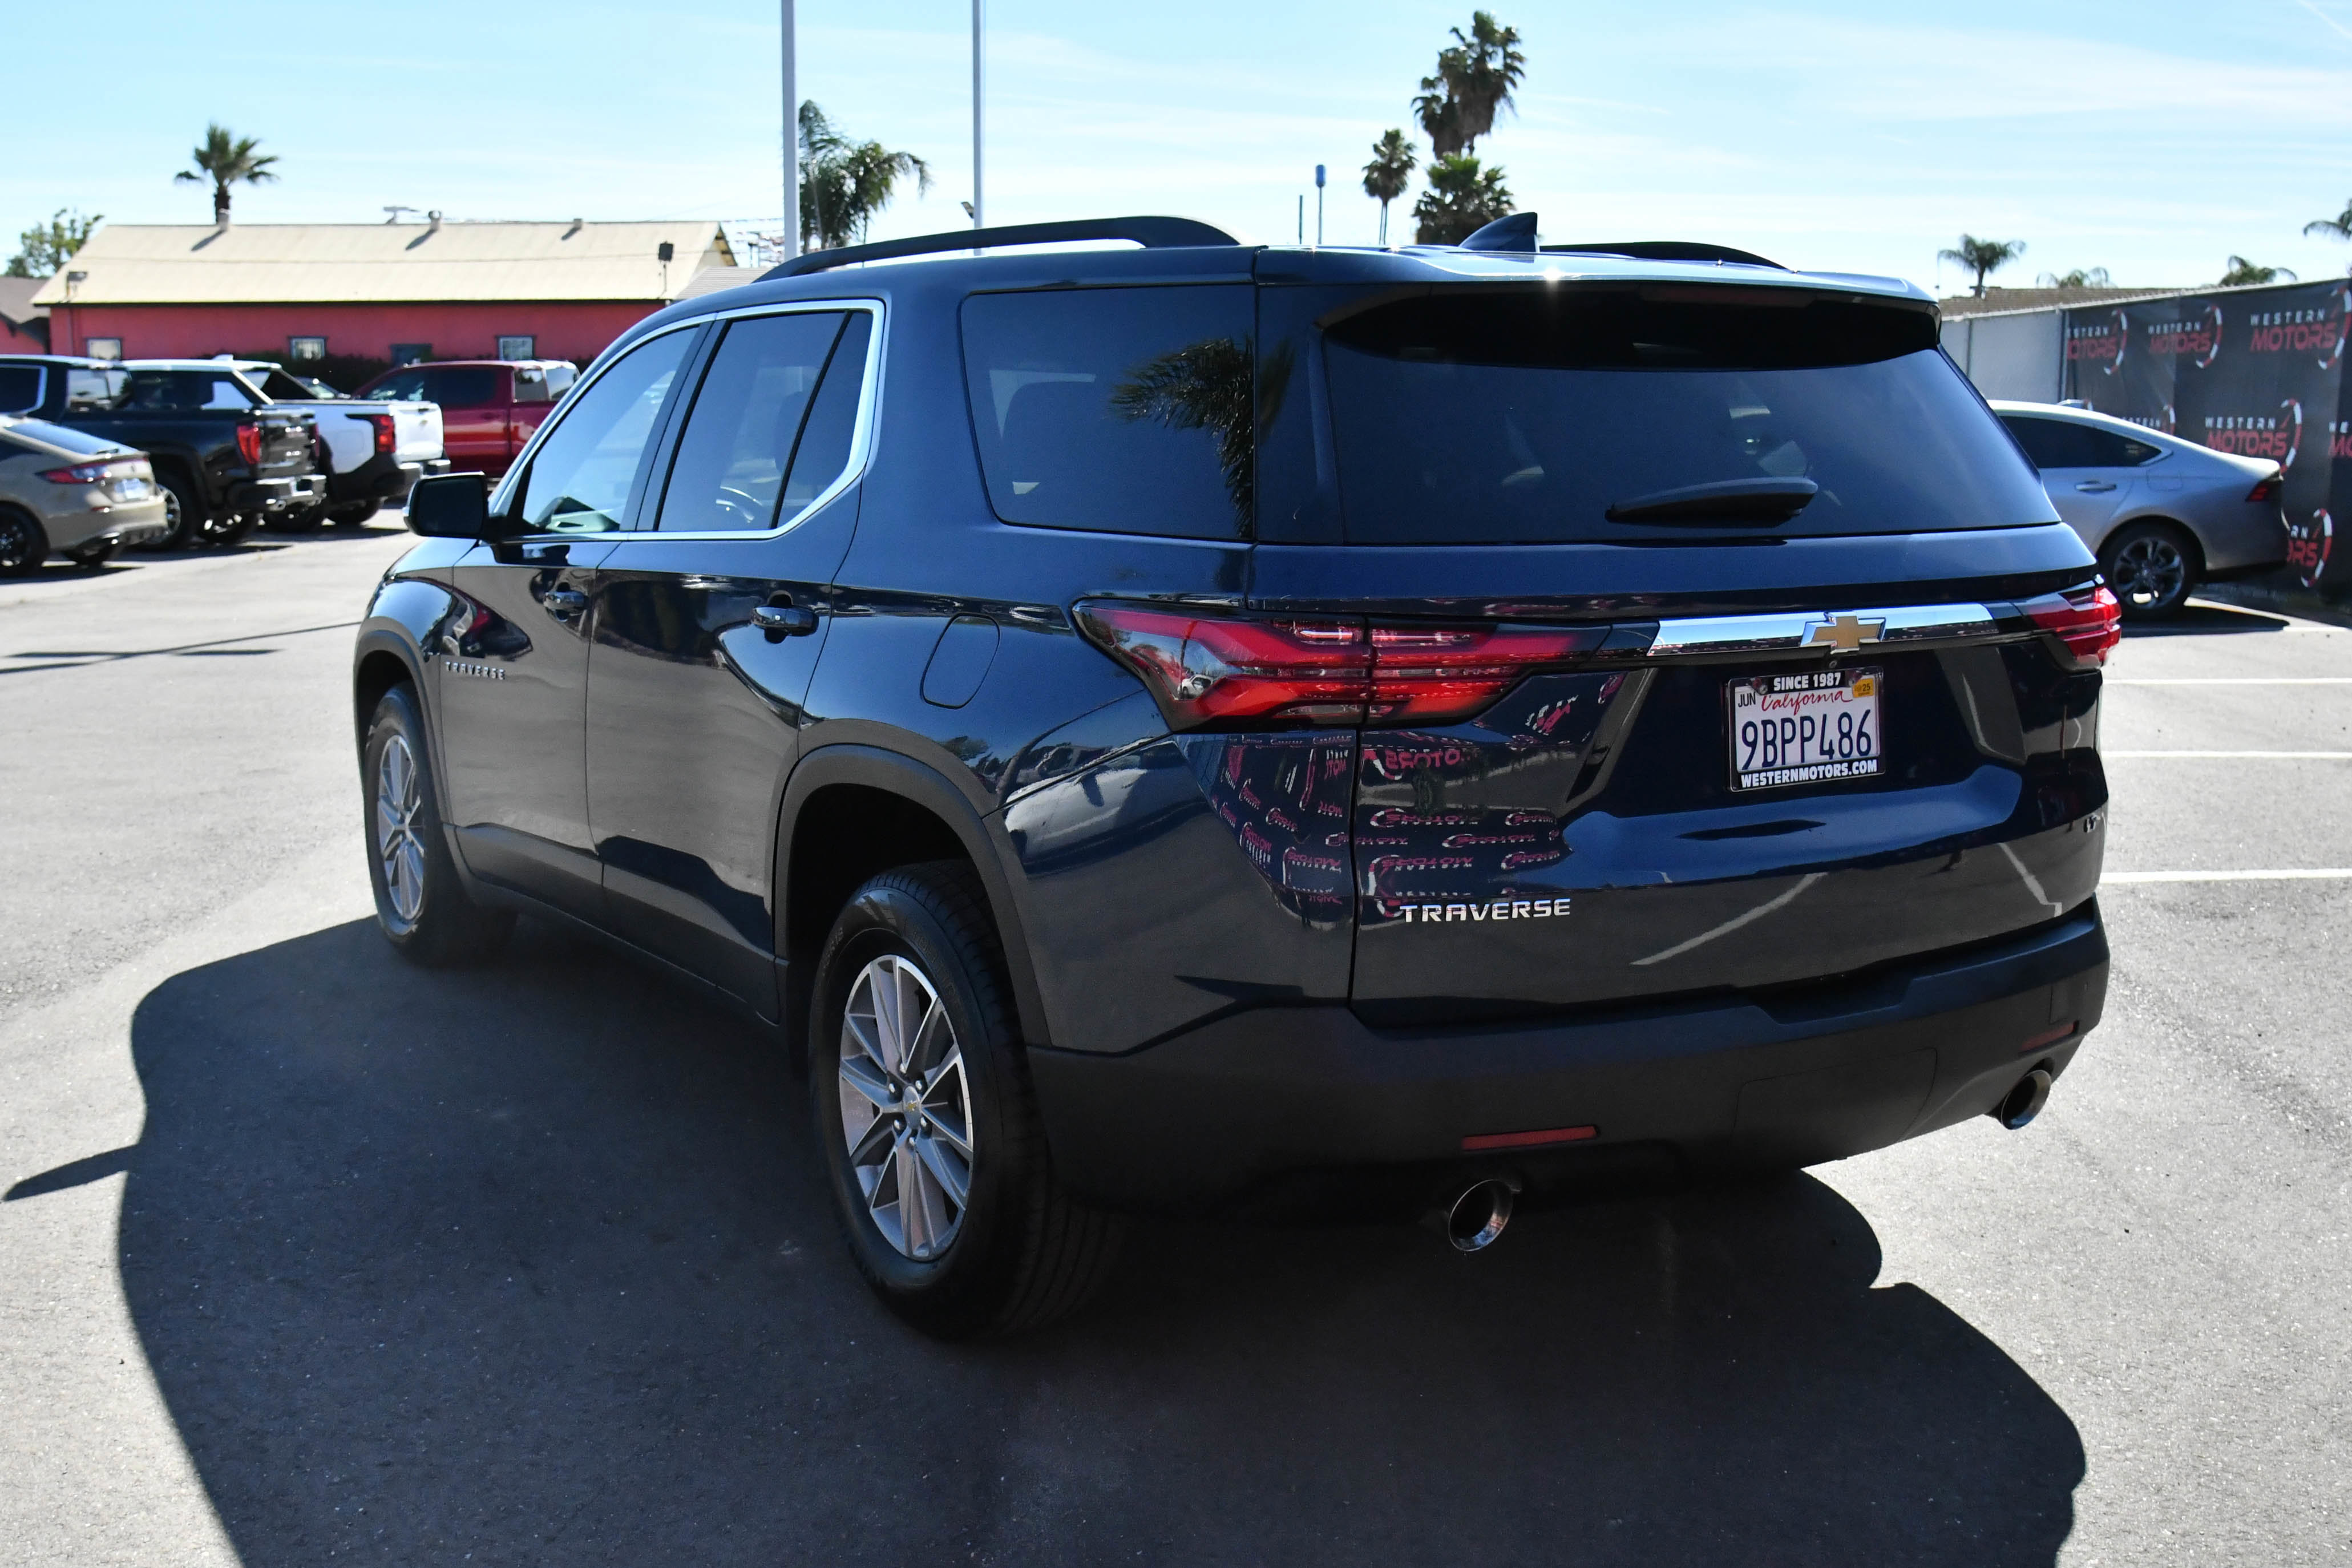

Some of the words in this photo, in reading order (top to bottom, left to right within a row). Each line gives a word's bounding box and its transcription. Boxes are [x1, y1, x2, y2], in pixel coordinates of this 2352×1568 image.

[2148, 321, 2201, 335] WESTERN
[2250, 308, 2325, 326] WESTERN
[2067, 336, 2117, 359] OTORS
[2250, 322, 2337, 352] MOTORS
[2205, 417, 2276, 430] WESTERN
[2206, 430, 2288, 456] MOTORS
[446, 661, 506, 680] TRAVERSE
[1773, 674, 1809, 692] SINCE
[1813, 672, 1841, 688] 1987
[1738, 692, 1756, 708] JUN
[1761, 690, 1853, 716] California
[1741, 709, 1871, 770] 9BPP486
[1741, 759, 1877, 788] WESTERNMOTORS.COM
[1400, 898, 1571, 923] TRAVERSE
